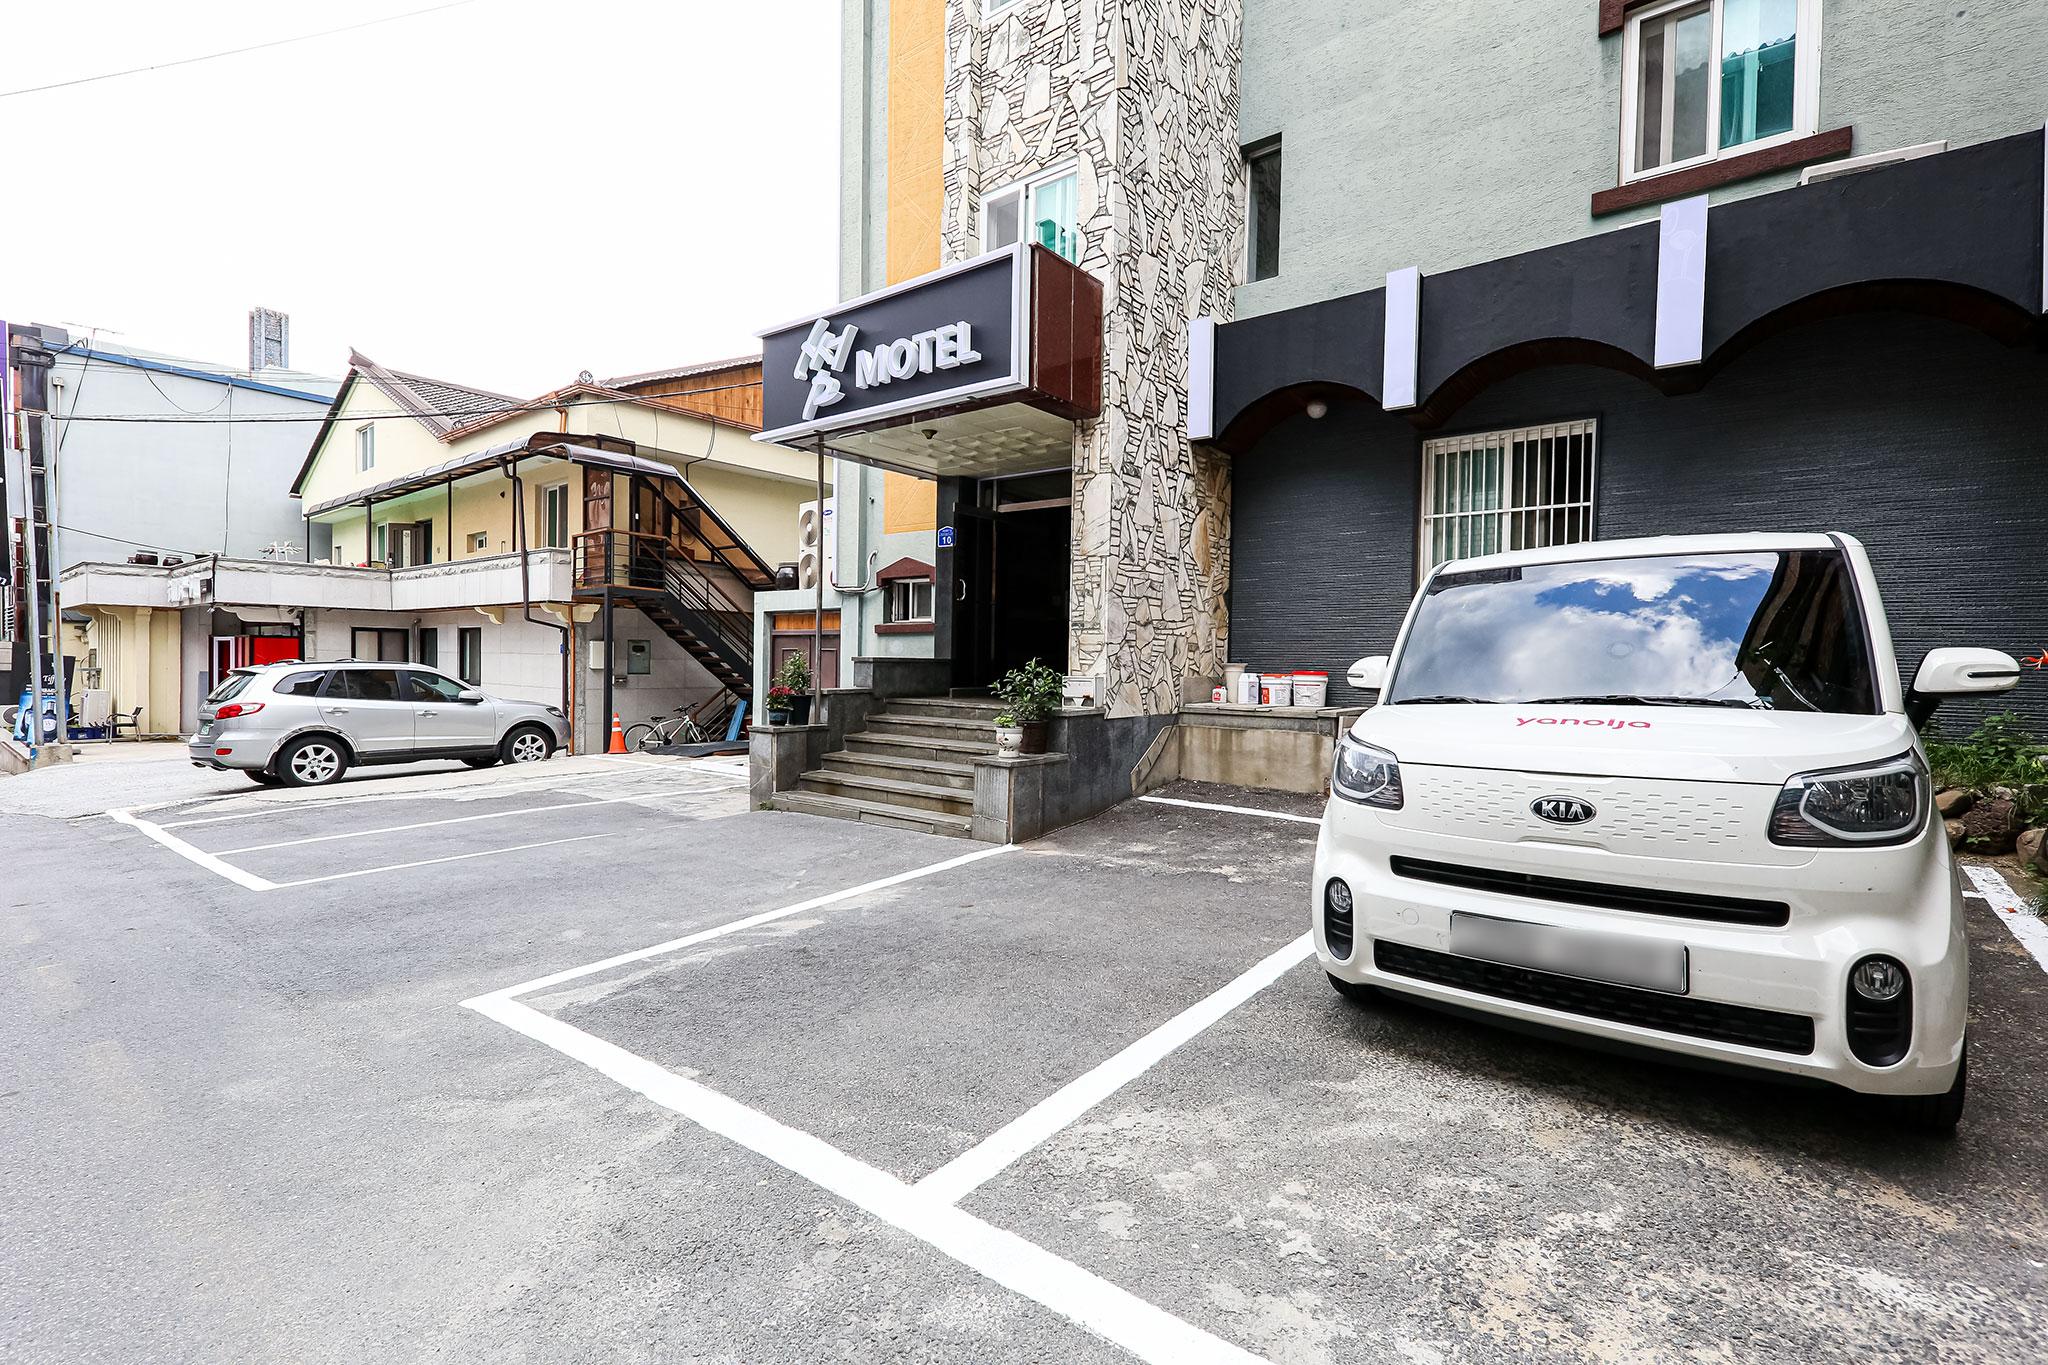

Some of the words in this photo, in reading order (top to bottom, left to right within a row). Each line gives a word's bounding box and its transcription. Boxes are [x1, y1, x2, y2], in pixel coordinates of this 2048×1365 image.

[855, 320, 982, 389] MOTEL
[942, 536, 952, 545] 10
[1541, 800, 1586, 820] KIA
